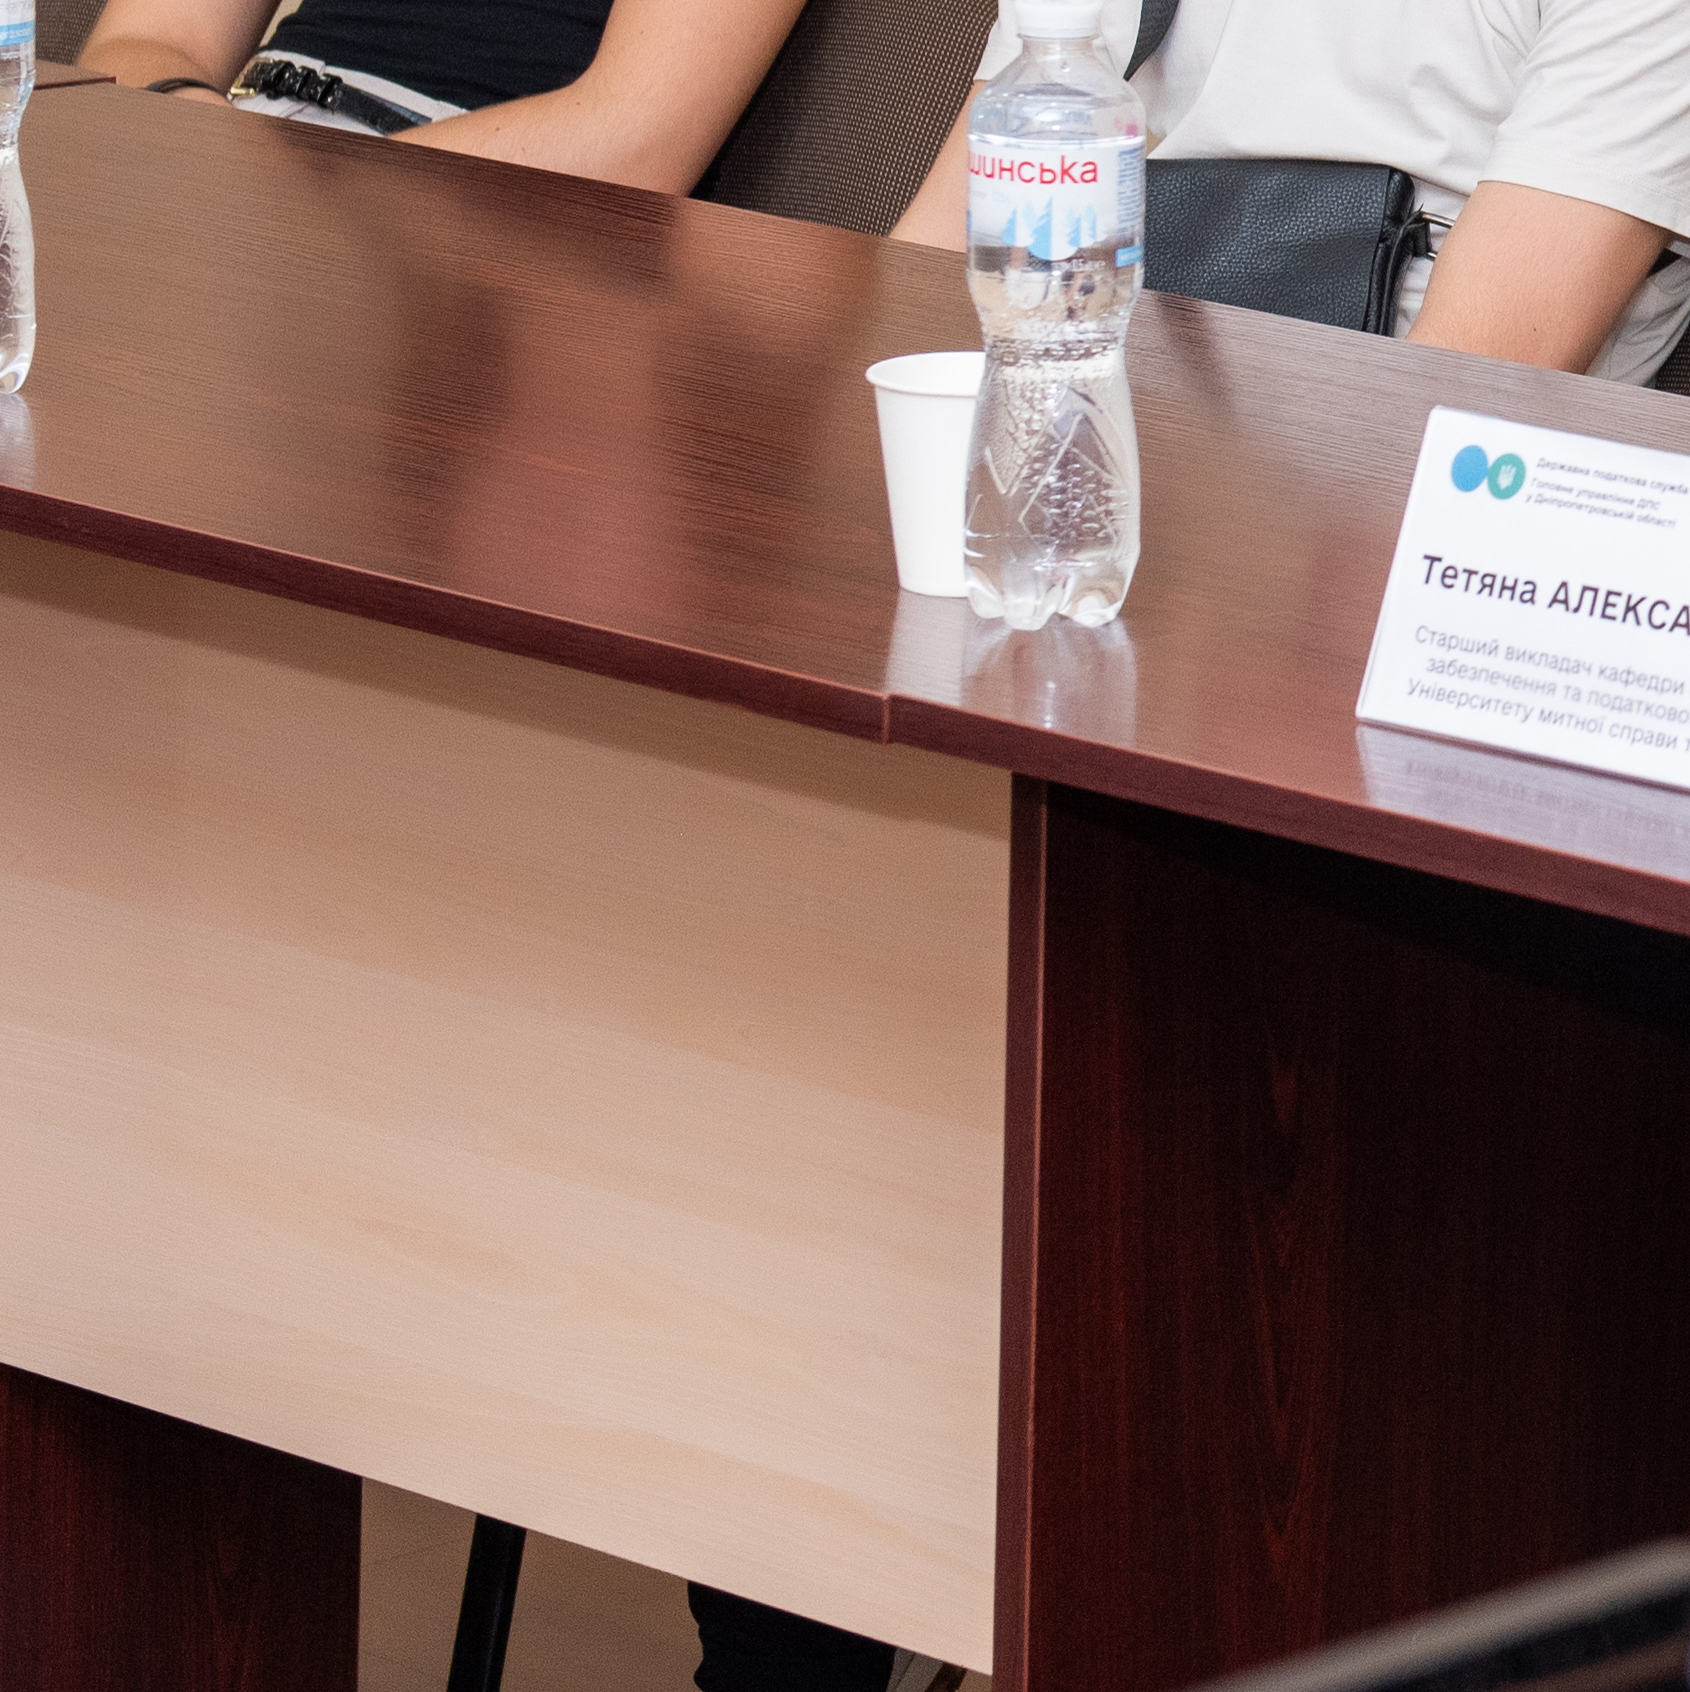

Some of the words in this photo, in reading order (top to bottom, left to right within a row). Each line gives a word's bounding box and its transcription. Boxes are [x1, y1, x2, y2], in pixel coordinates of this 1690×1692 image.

[1531, 478, 1574, 494] Головне
[1576, 487, 1635, 506] управління
[1637, 498, 1661, 511] ДПС
[1536, 458, 1590, 476] Державна
[1593, 469, 1647, 487] податкова
[1650, 479, 1688, 495] служба
[1637, 513, 1677, 528] області
[1423, 554, 1537, 605] Тетяна
[1415, 625, 1499, 658] Старший
[1504, 645, 1593, 676] викладач
[1597, 664, 1685, 695] кафедри
[1426, 657, 1557, 698] забезпечення
[1563, 684, 1582, 703] та
[1407, 678, 1534, 724] Університету
[1537, 708, 1606, 735] митної
[1608, 722, 1679, 749] справи
